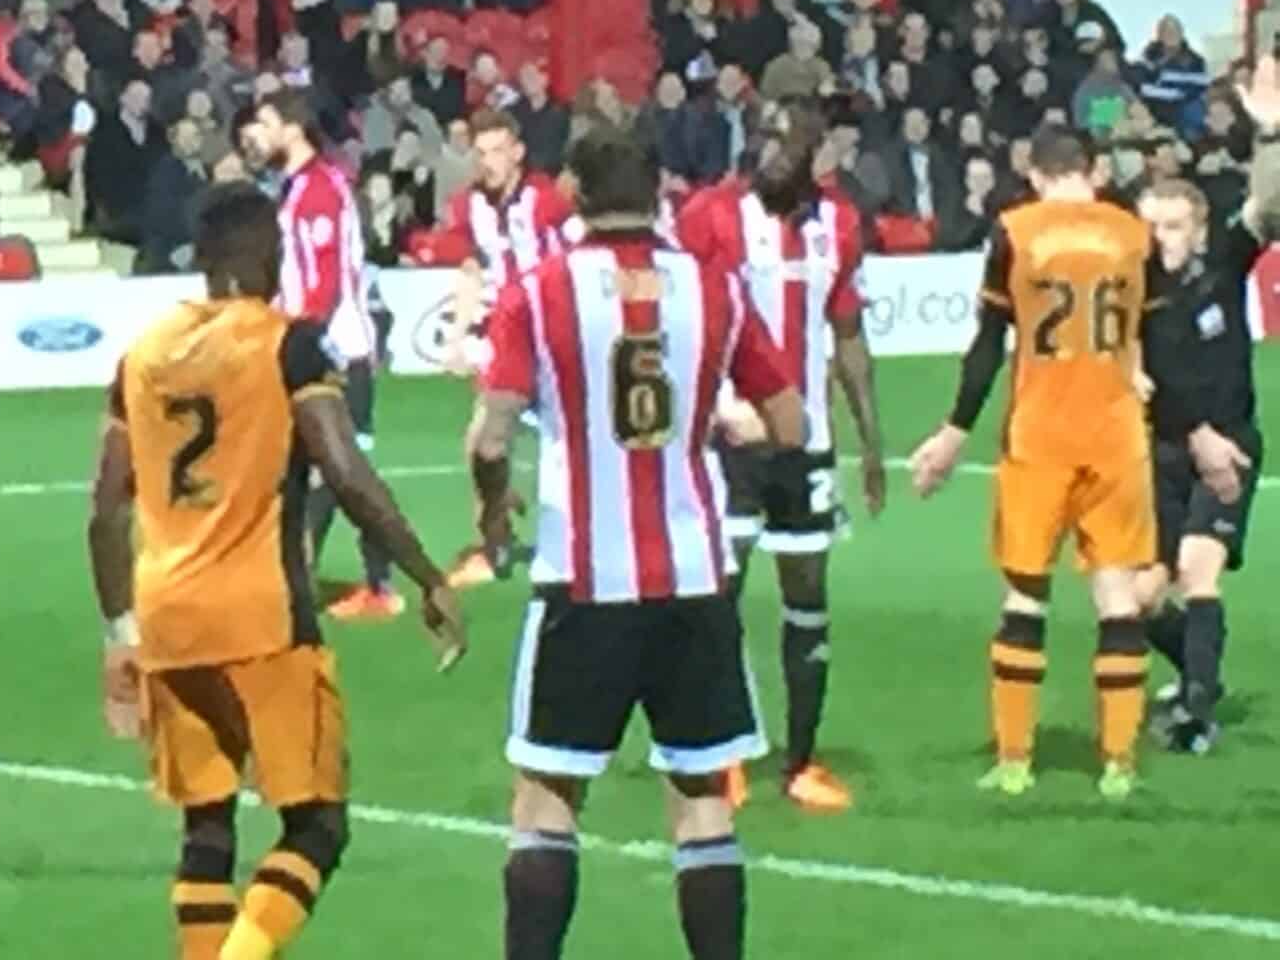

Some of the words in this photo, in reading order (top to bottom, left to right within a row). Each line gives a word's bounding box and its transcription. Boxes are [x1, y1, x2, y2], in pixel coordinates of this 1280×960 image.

[1025, 275, 1130, 358] 26
[608, 333, 677, 449] 6
[160, 394, 220, 508] 2
